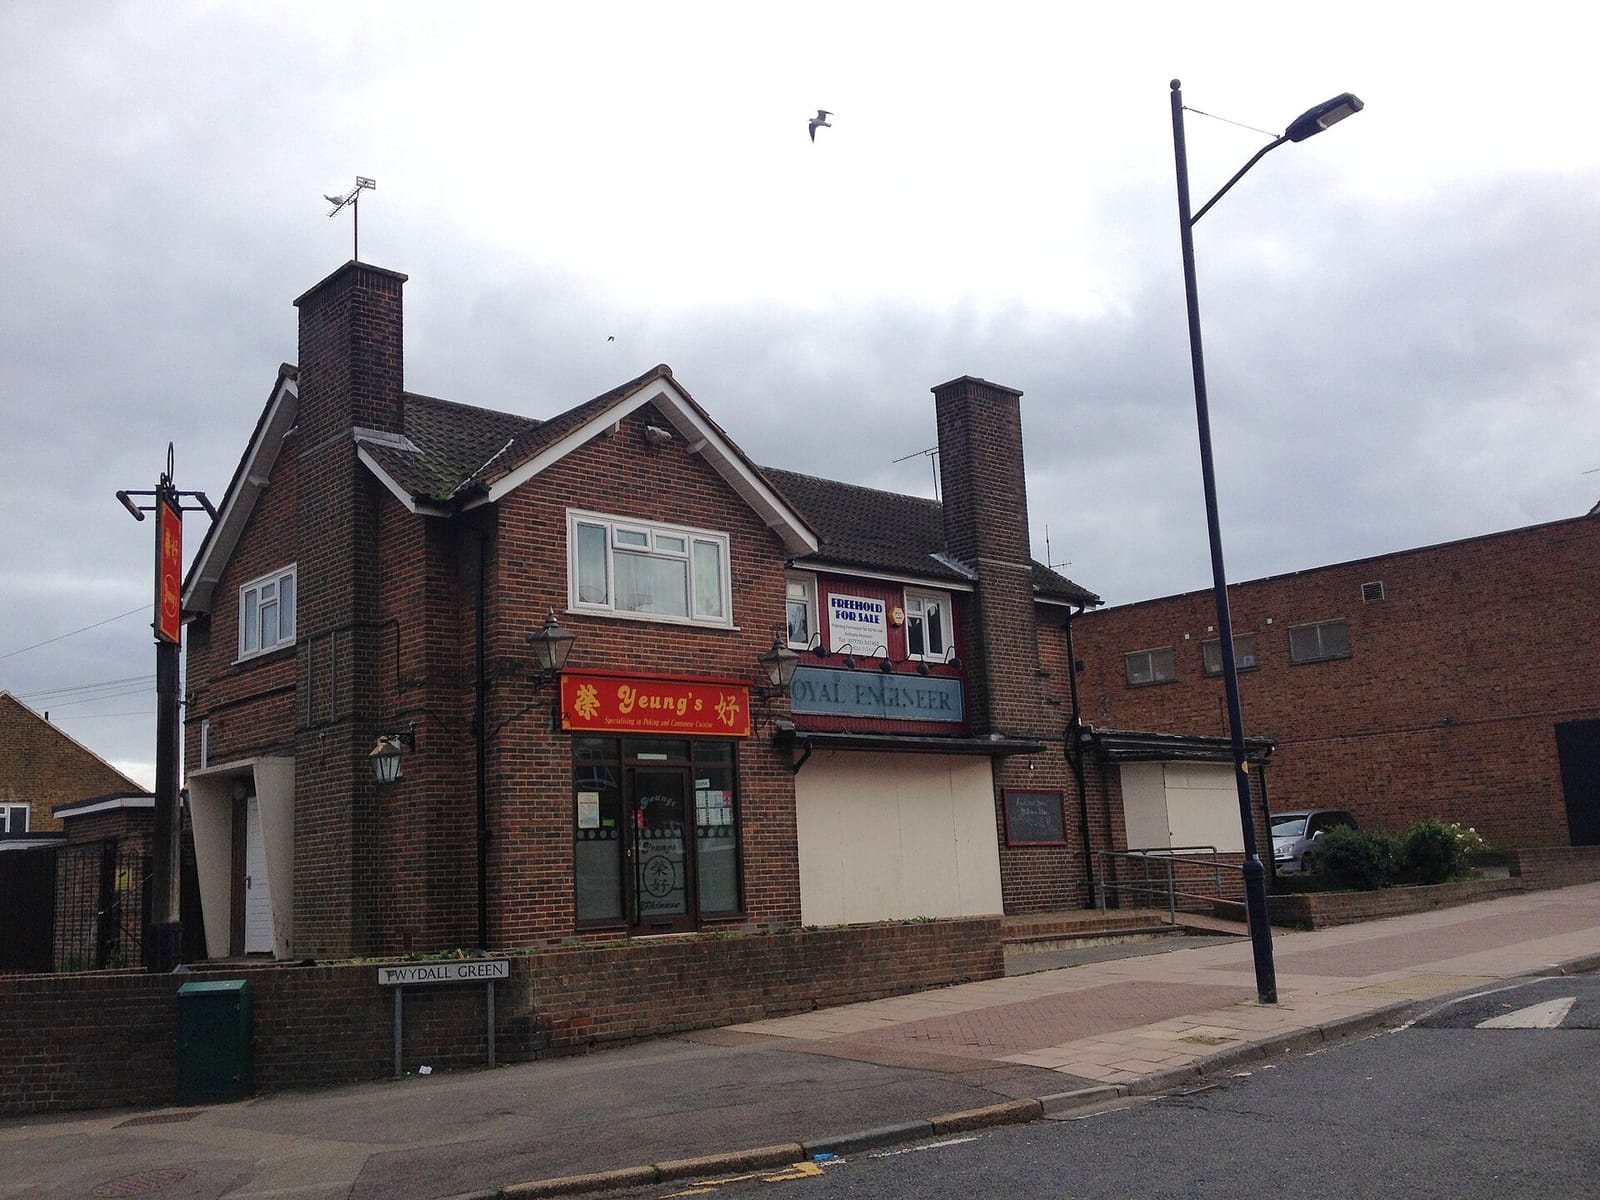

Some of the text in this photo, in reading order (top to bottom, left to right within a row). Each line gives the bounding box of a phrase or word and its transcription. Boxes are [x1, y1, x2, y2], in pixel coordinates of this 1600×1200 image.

[831, 597, 883, 613] FREEHOLD
[835, 610, 856, 622] FOR
[858, 612, 881, 624] SALE
[617, 684, 703, 717] Yeung's
[791, 679, 951, 711] OYAL ENGINEER
[714, 692, 740, 728] 好
[458, 963, 503, 978] GREEN
